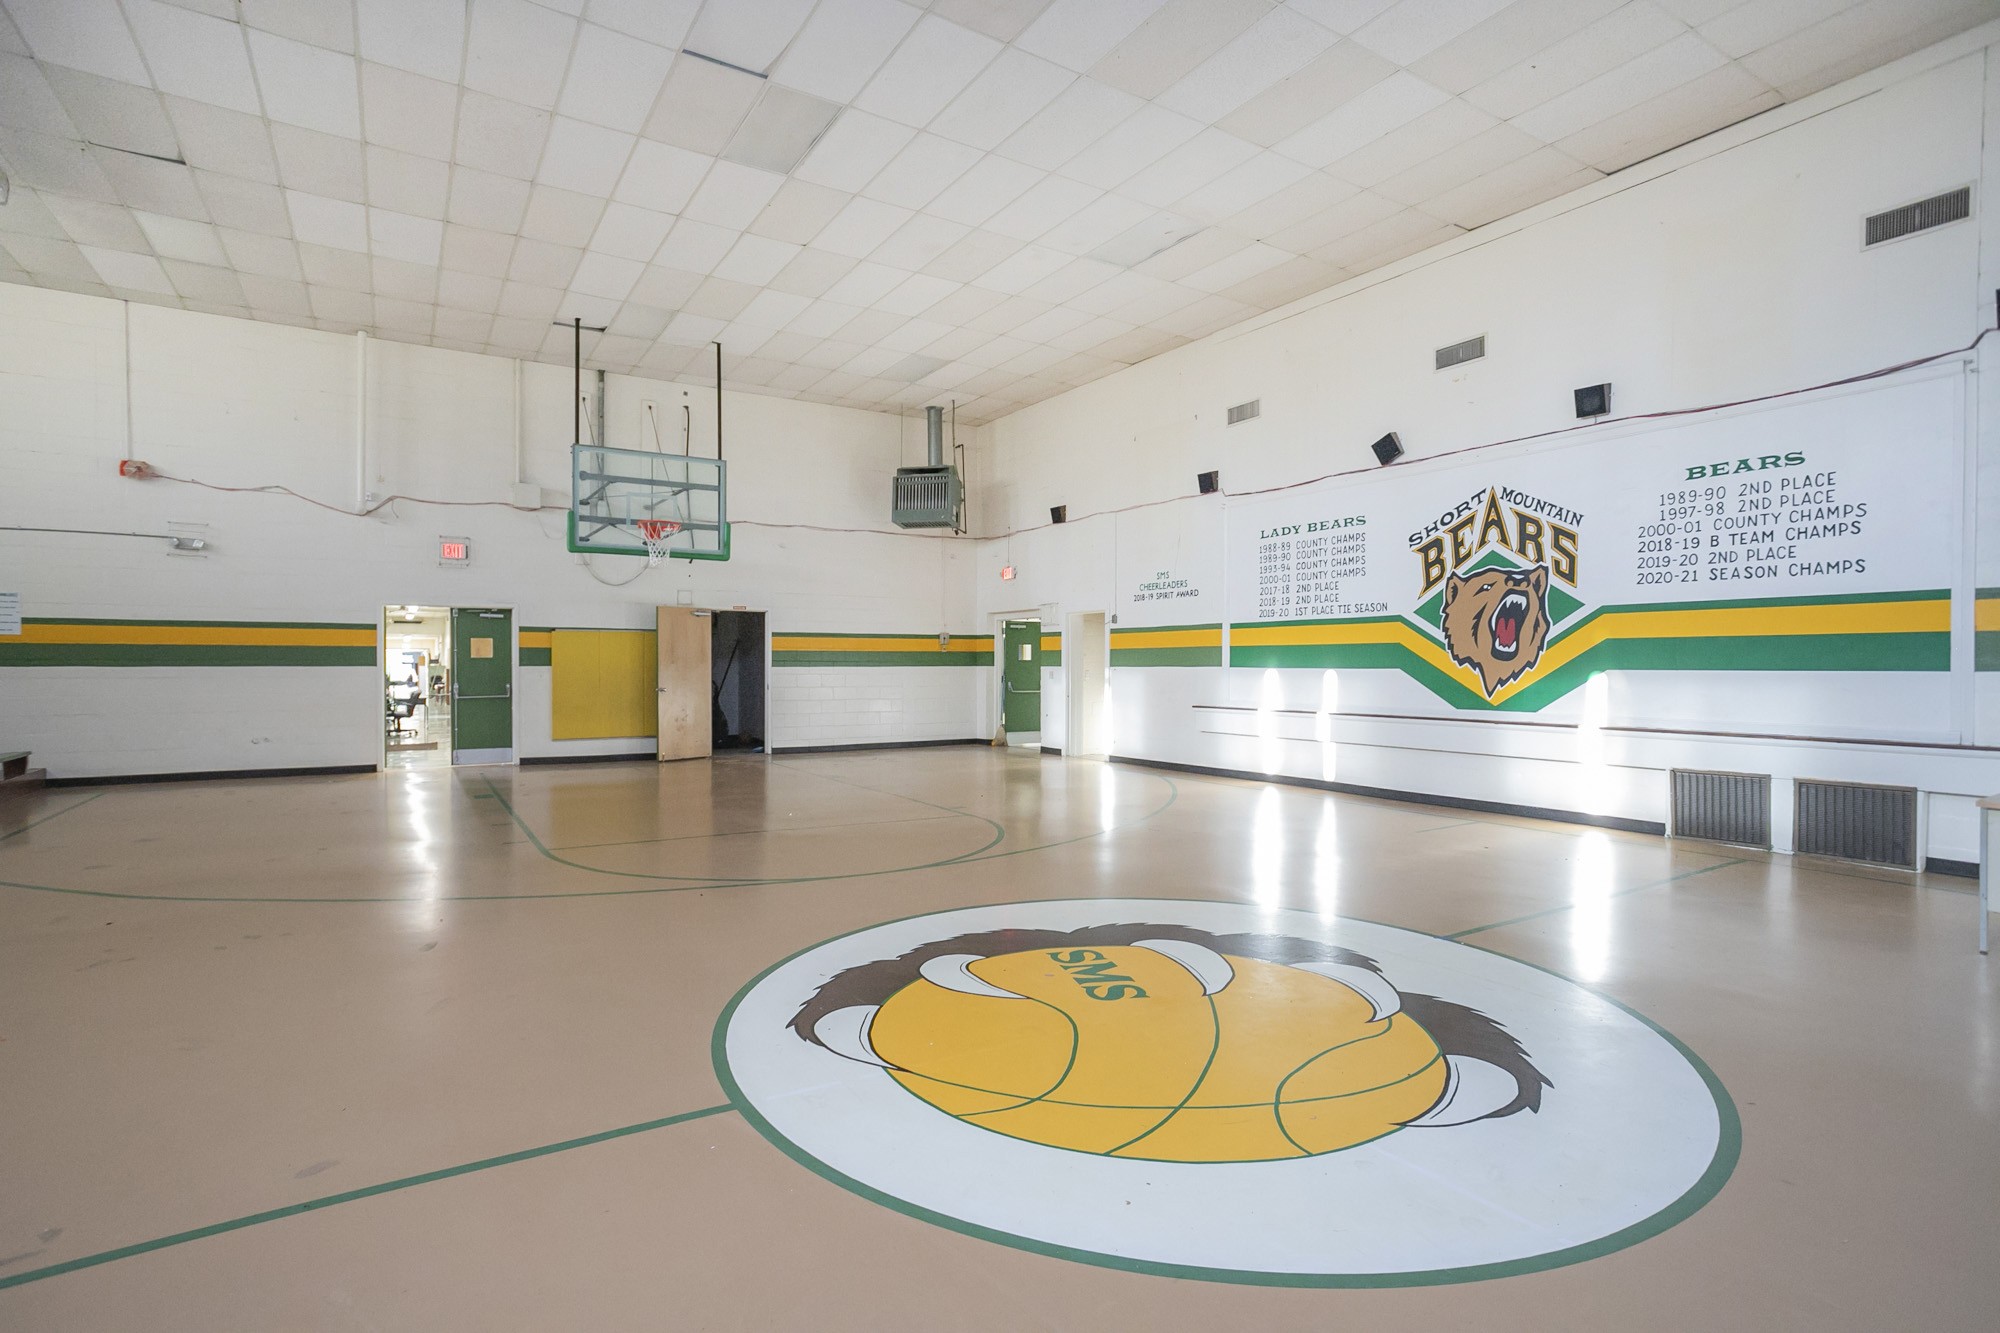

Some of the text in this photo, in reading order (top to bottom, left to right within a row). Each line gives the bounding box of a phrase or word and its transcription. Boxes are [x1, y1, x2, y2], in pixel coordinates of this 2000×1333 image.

[1685, 451, 1806, 481] BEARS
[1659, 471, 1837, 506] 1989-90 2ND PLACE
[1660, 489, 1836, 521] 1997-98 2ND PLACE
[1260, 516, 1366, 539] LADY BEARS
[1408, 486, 1584, 548] SHORT MOUNTAIN
[1638, 503, 1867, 539] 2000-01 COUNTY CHAMPS
[1259, 533, 1366, 554] 1988-89 COUNTY CHAMPS
[1412, 486, 1579, 600] BEARS
[1637, 521, 1862, 553] 2018-19 B TEAM CHAMPS
[443, 543, 464, 558] EXIT
[1259, 544, 1366, 564] 1989-90 COUNTY CHAMPS
[1637, 546, 1796, 569] 2019-20 2ND PLACE
[1157, 571, 1169, 580] SMS
[1260, 556, 1366, 574] 1993-94 COUNTY CHAMPS
[1260, 567, 1366, 584] 2000-01 COUNTY CHAMPS
[1637, 559, 1866, 585] 2020-21 SEASON CHAMPS
[1134, 593, 1153, 602] 2018-19
[1176, 589, 1199, 598] AWARD
[1139, 580, 1188, 591] CHEERLEADERS
[1260, 581, 1339, 595] 2017-18 2ND PLACE
[1259, 593, 1339, 606] 2018-19 2ND PLACE
[1259, 603, 1388, 618] 2019-20 1ST PLACE TIE SEASON
[1047, 949, 1151, 1001] SMS
